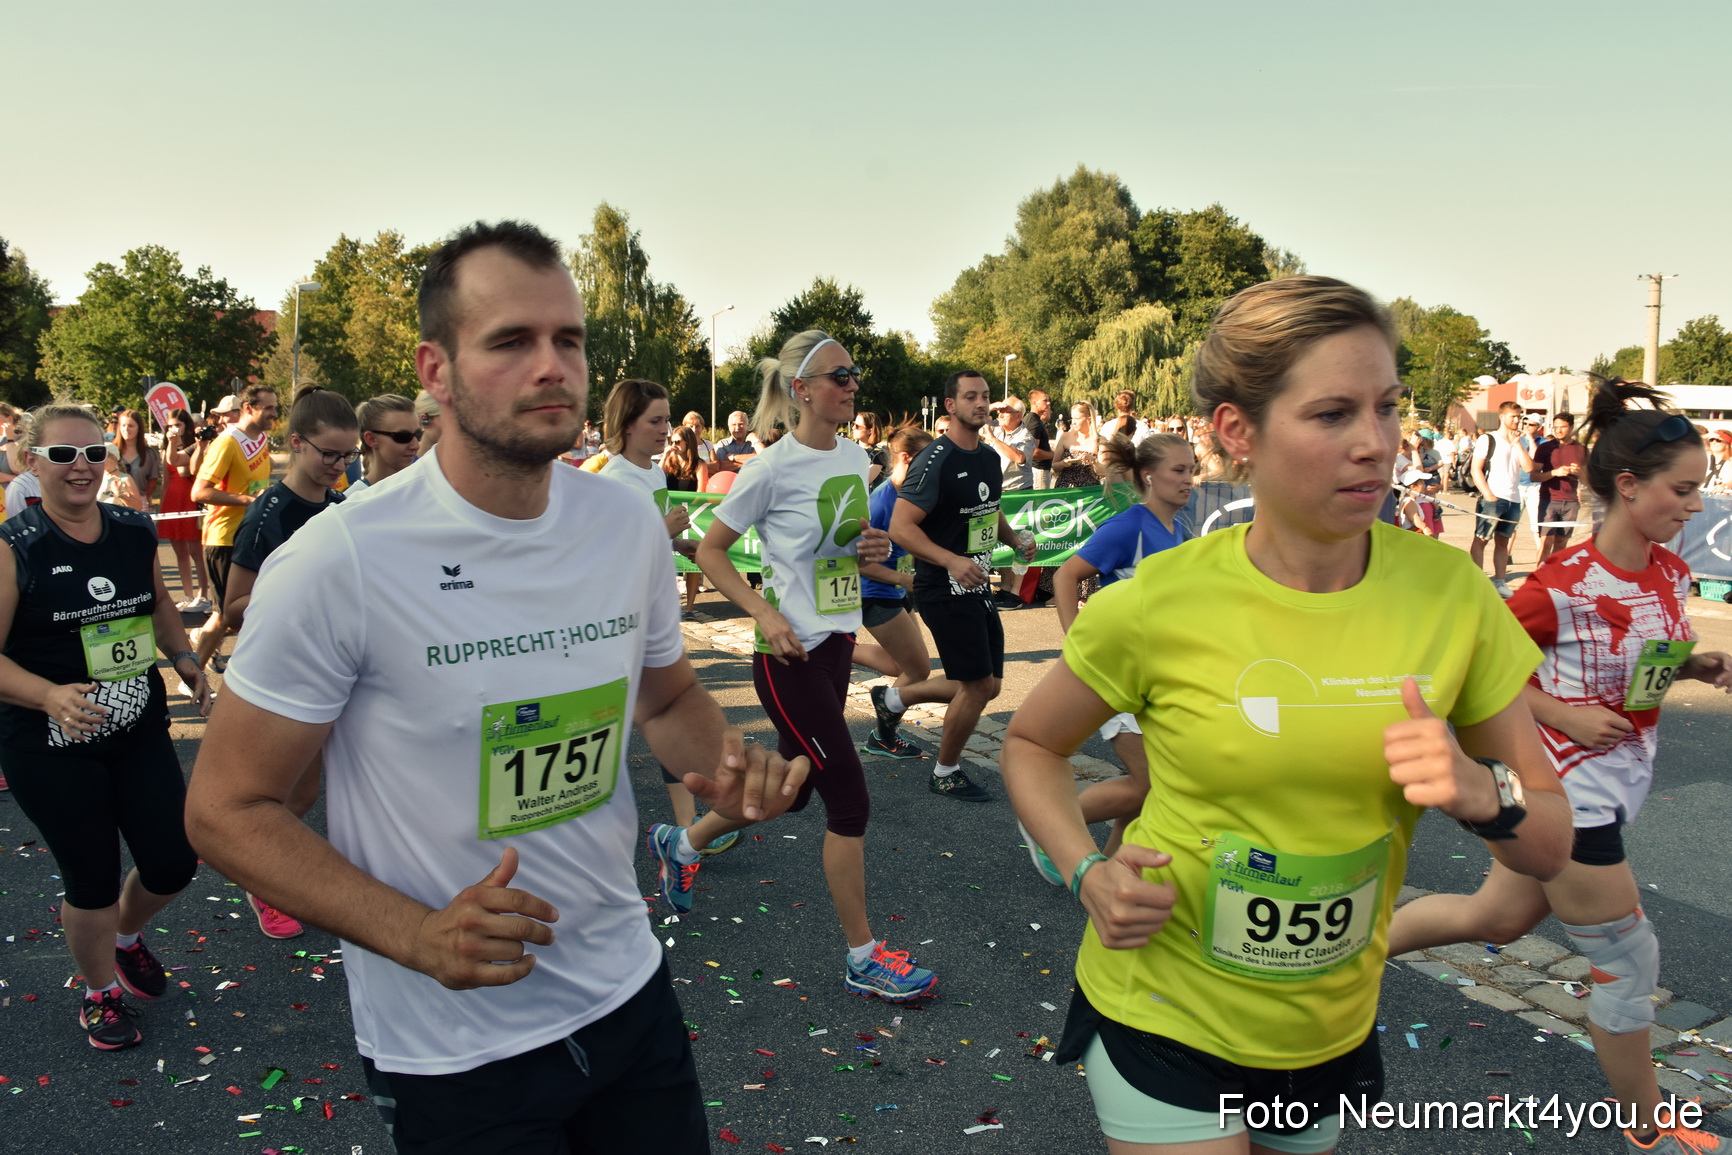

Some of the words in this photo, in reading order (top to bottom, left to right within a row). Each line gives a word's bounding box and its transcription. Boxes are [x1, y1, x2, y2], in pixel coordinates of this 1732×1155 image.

[1009, 498, 1104, 539] AOK
[981, 527, 994, 541] 82
[52, 565, 73, 575] JAKO
[440, 580, 475, 591] erima
[80, 606, 137, 625] SCHOTTERWERKE
[427, 630, 555, 666] RUPPRECHT
[568, 611, 640, 645] HOLZBAU
[112, 639, 137, 664] 63
[93, 663, 131, 676] Grillenberger
[1321, 676, 1365, 686] Kliniken
[1367, 675, 1385, 684] des
[1355, 686, 1402, 696] Neumark
[505, 728, 611, 797] 1757
[517, 793, 556, 811] Walter
[558, 780, 599, 801] Andreas
[510, 806, 552, 823] Rupprecht
[554, 798, 582, 813] Holzbau
[1234, 862, 1303, 887] firmenlauf
[1308, 883, 1345, 897] 2018
[1246, 897, 1353, 947] 959
[1212, 945, 1244, 962] Kliniken
[1245, 955, 1260, 966] des
[1261, 957, 1311, 969] Landkreises
[1241, 942, 1300, 960] Schlierf
[1304, 937, 1352, 959] Claudia
